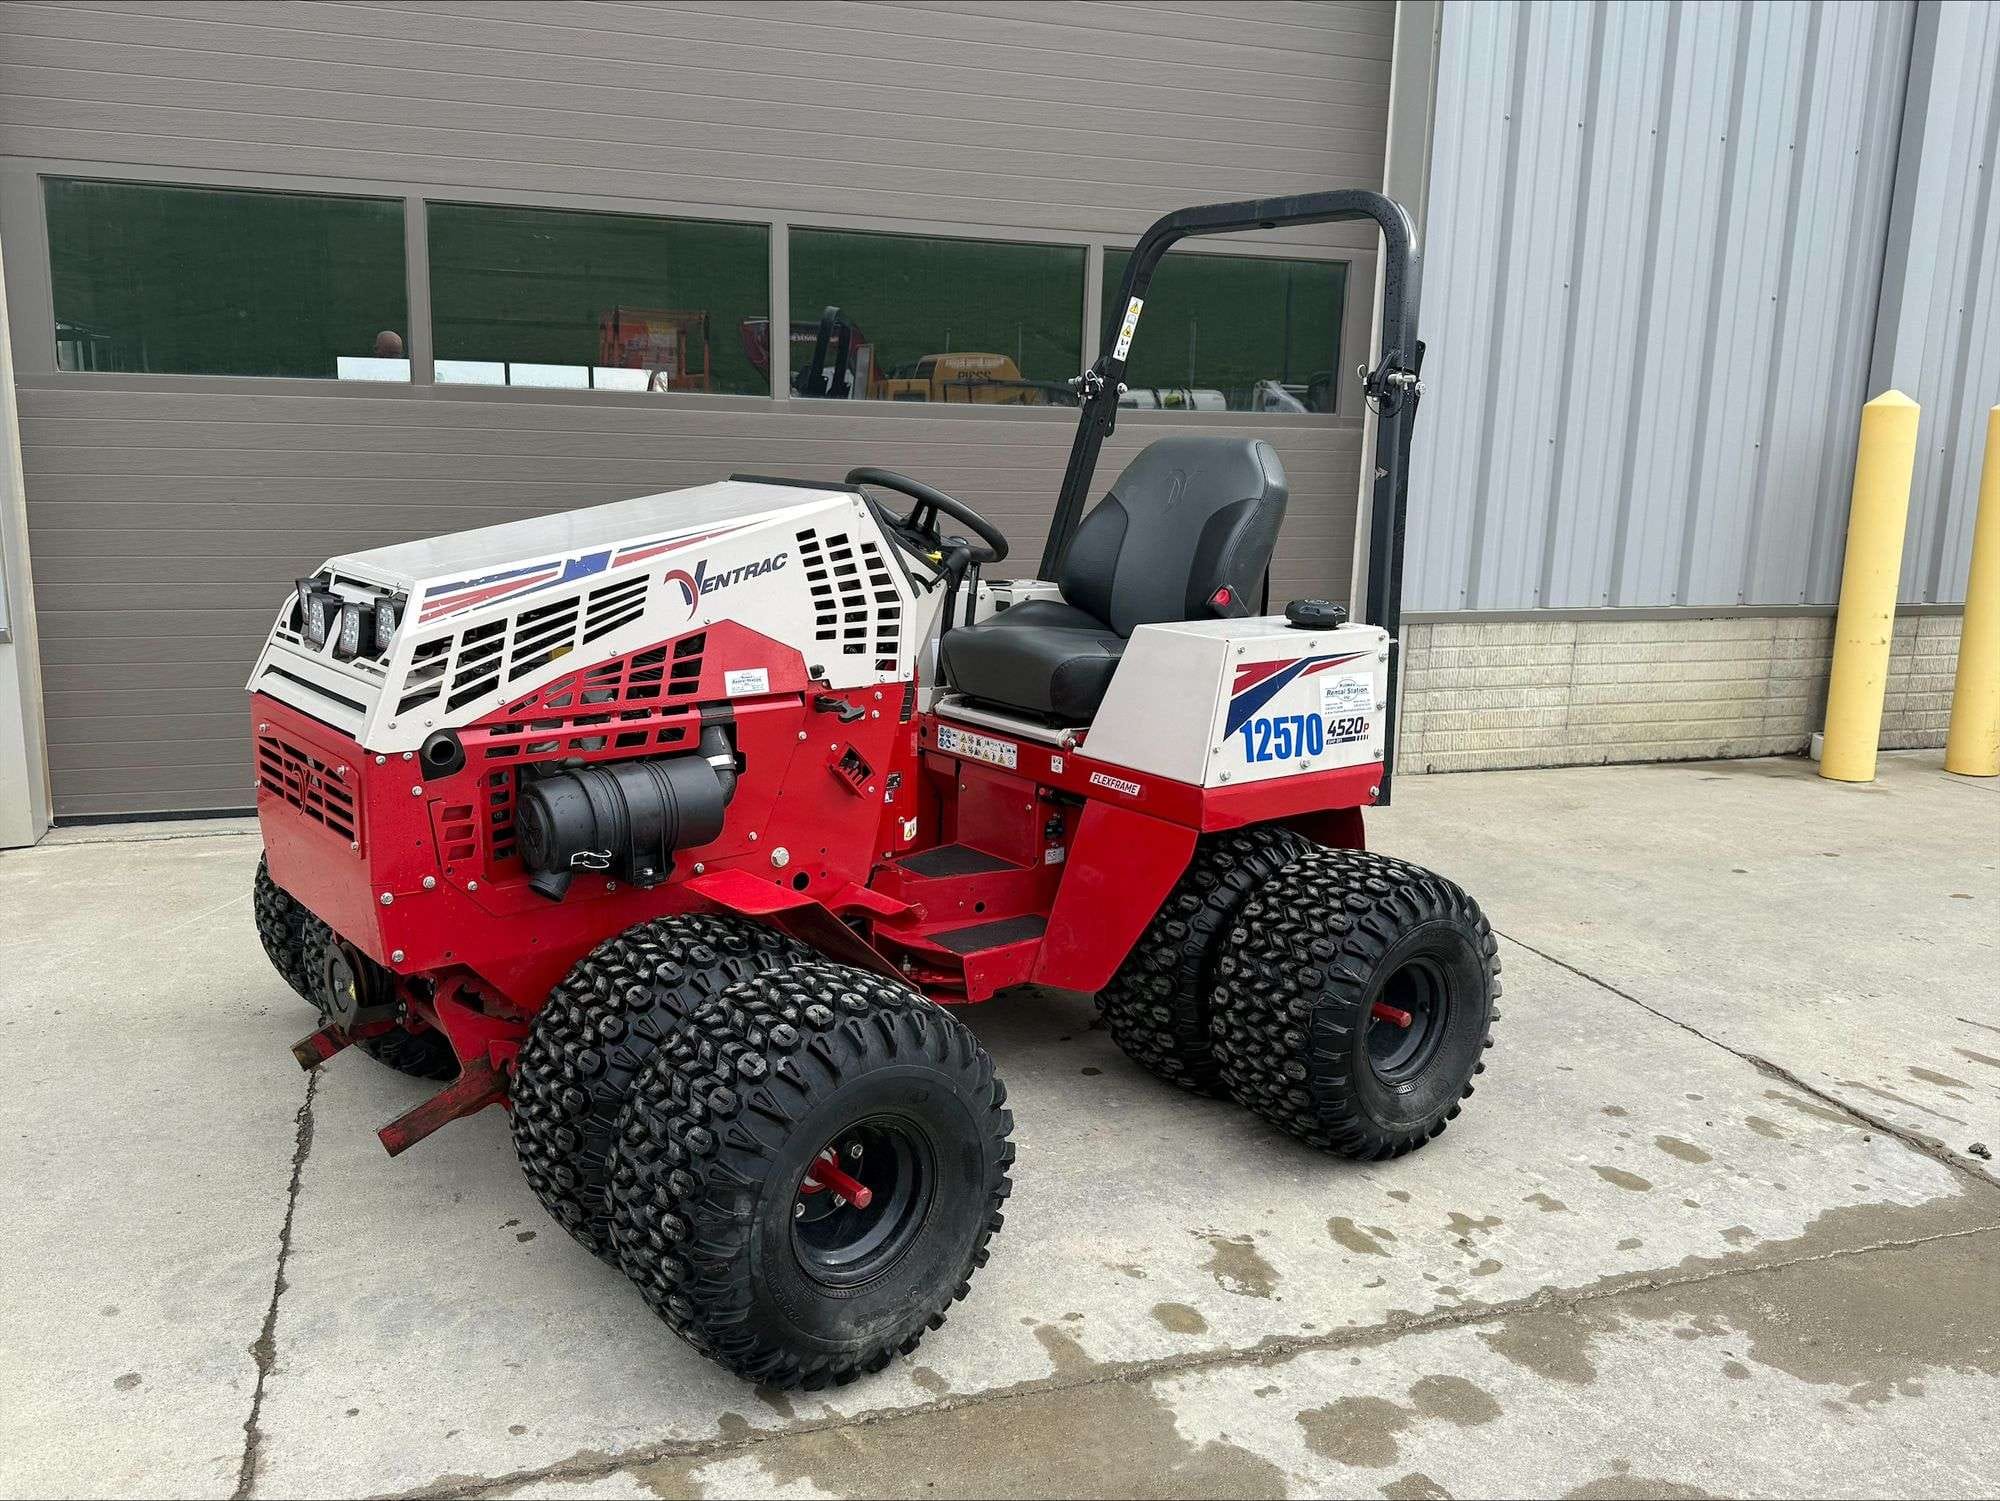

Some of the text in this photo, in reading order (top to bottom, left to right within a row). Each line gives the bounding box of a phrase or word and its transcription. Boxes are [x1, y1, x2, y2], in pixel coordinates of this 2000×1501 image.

[664, 552, 788, 622] VENTRAC
[1239, 712, 1324, 763] 12570
[1092, 773, 1138, 794] FLEXFRAME
